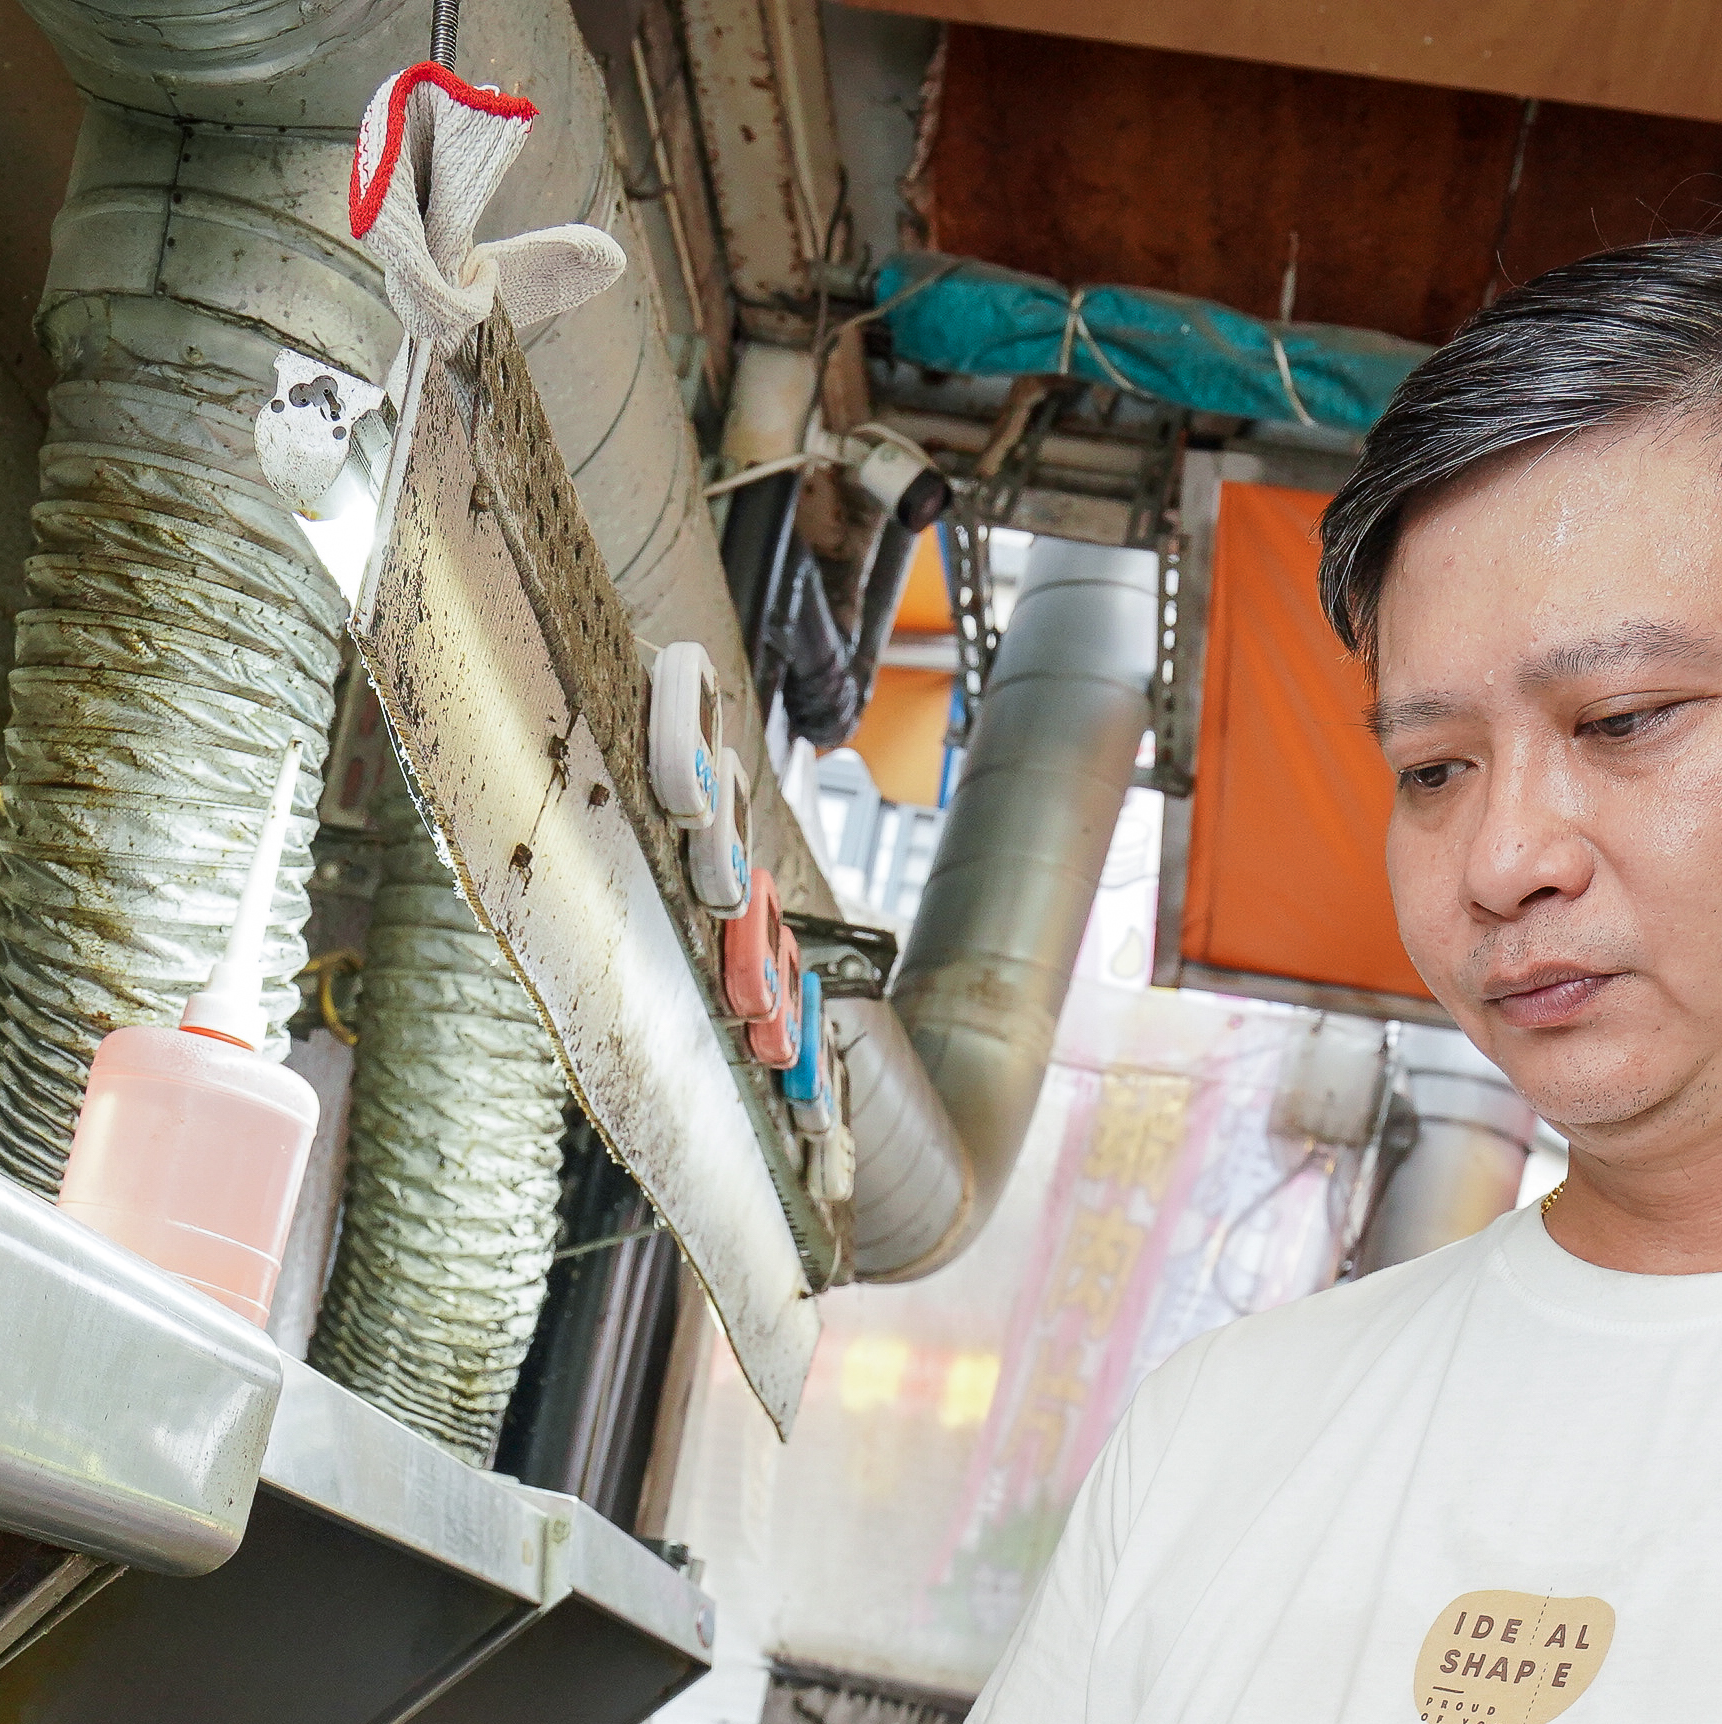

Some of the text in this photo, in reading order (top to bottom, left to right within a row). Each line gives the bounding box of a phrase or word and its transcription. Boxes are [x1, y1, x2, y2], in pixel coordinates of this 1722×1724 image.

[1453, 1611, 1590, 1650] IDEAL
[1439, 1649, 1573, 1688] SHAPE
[1420, 1712, 1443, 1724] OF
[1425, 1697, 1496, 1716] PROUD
